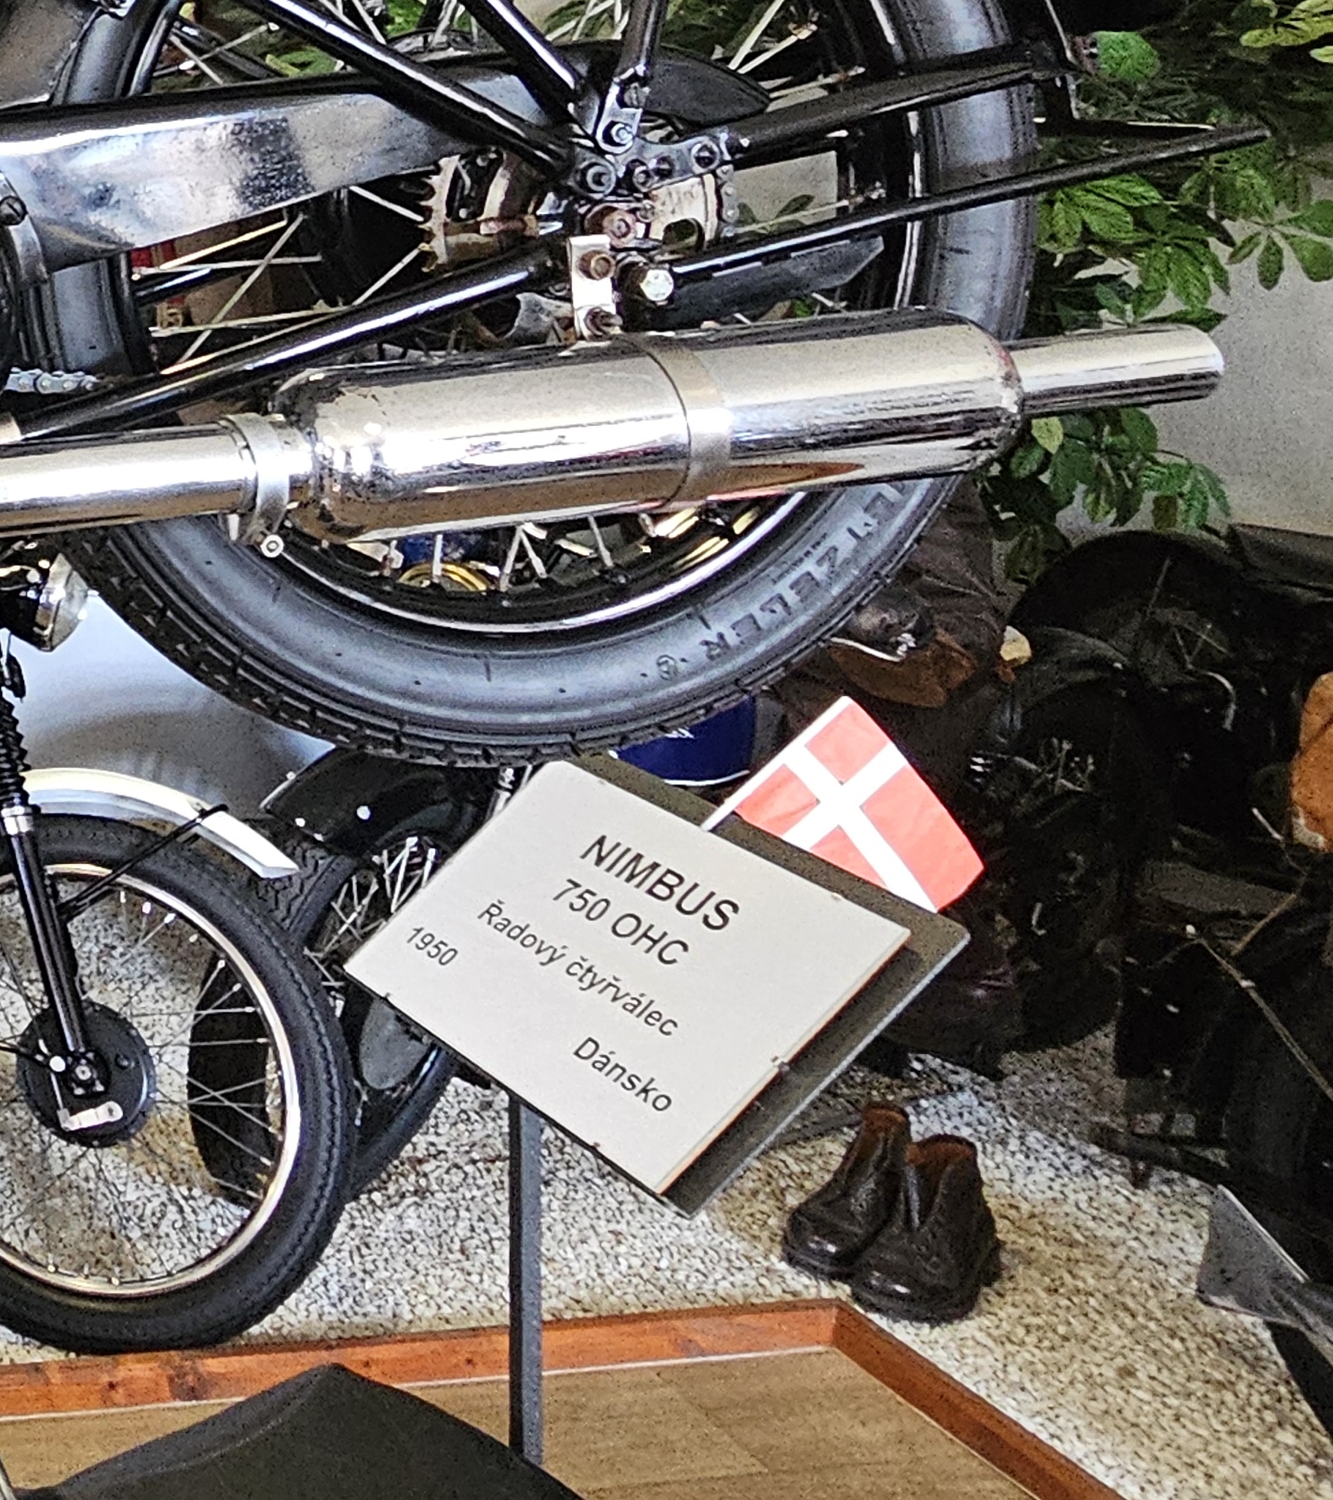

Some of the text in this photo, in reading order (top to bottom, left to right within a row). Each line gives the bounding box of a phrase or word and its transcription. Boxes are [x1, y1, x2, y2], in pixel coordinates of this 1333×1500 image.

[552, 878, 690, 965] 750 OHC
[580, 834, 740, 932] NIMBUS
[405, 925, 459, 967] 1950
[476, 898, 679, 1038] Řadový čtyřválec
[572, 1036, 673, 1113] Dánsko
